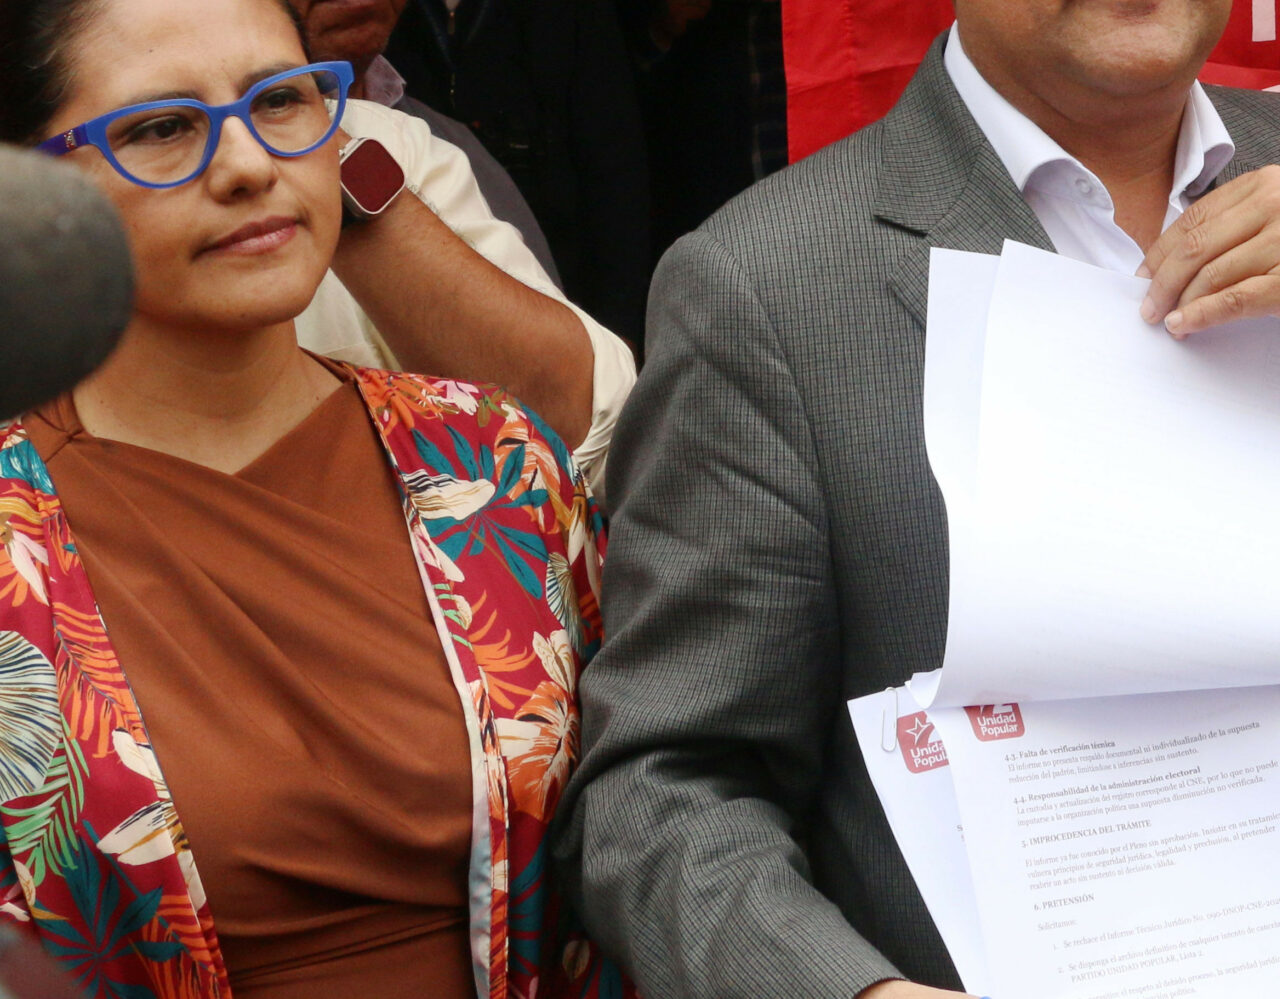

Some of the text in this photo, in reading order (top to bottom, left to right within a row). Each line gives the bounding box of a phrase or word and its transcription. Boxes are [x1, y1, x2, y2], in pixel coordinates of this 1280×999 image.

[977, 712, 1017, 727] Unidad
[980, 723, 1018, 737] Popular
[1152, 732, 1207, 751] individualizado
[1227, 721, 1260, 735] supuesta
[910, 740, 946, 758] Unida
[1019, 749, 1038, 759] Falta
[1050, 743, 1090, 754] verificación
[914, 752, 947, 768] Popul
[1040, 771, 1051, 780] del
[1155, 754, 1165, 762] sin
[1207, 775, 1219, 785] por
[1229, 770, 1244, 780] que
[1256, 760, 1279, 773] puede
[1028, 785, 1089, 801] Responsabilidad
[1108, 775, 1164, 790] administración
[1165, 766, 1201, 780] electoral
[1029, 828, 1097, 846] IMPROCEDENCIA
[1099, 825, 1115, 834] DEL
[1116, 819, 1152, 832] TRÁMITE
[1042, 892, 1095, 909] PRETENSIÓN
